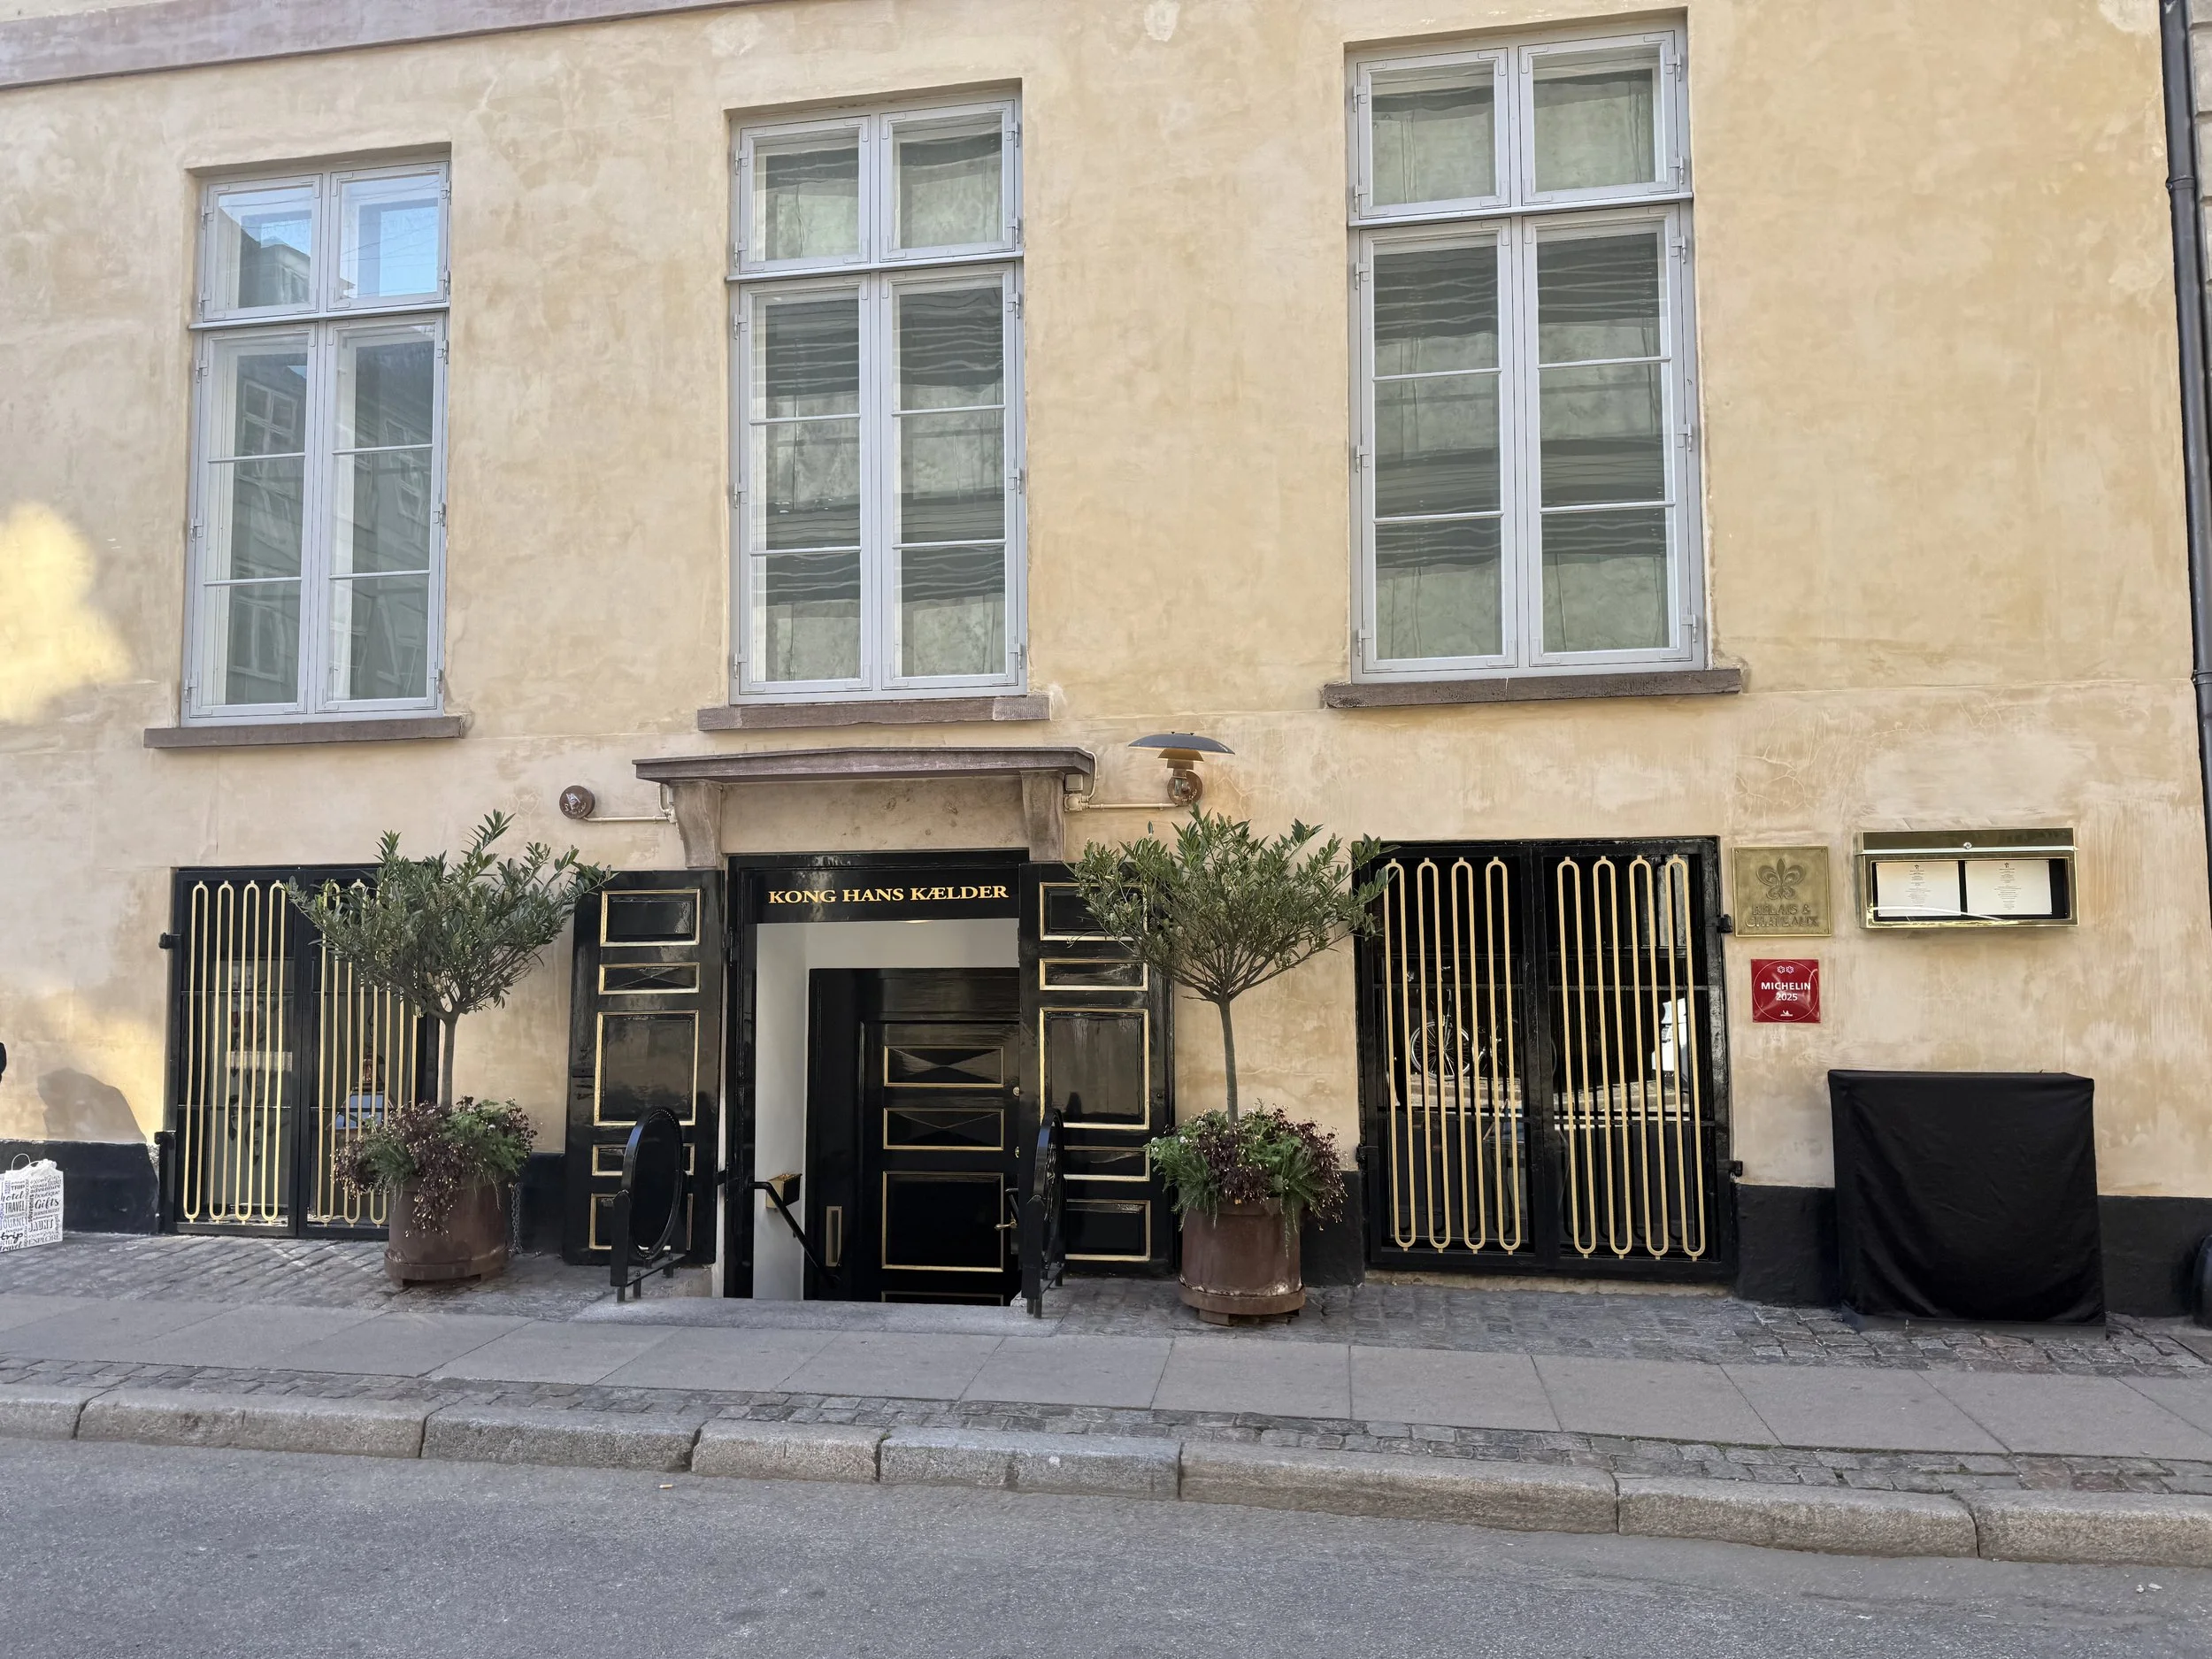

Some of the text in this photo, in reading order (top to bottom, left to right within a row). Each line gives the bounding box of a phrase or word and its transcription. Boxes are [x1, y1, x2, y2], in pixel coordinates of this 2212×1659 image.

[768, 885, 1010, 904] KONG HANS KÆLDER
[1752, 902, 1811, 916] RELAIS &
[1761, 981, 1811, 991] MICHELIN
[1775, 993, 1798, 1002] 2025
[30, 1185, 61, 1194] adventure
[5, 1201, 25, 1213] TRAVEL
[35, 1197, 59, 1210] Gifts
[0, 1233, 23, 1244] trip
